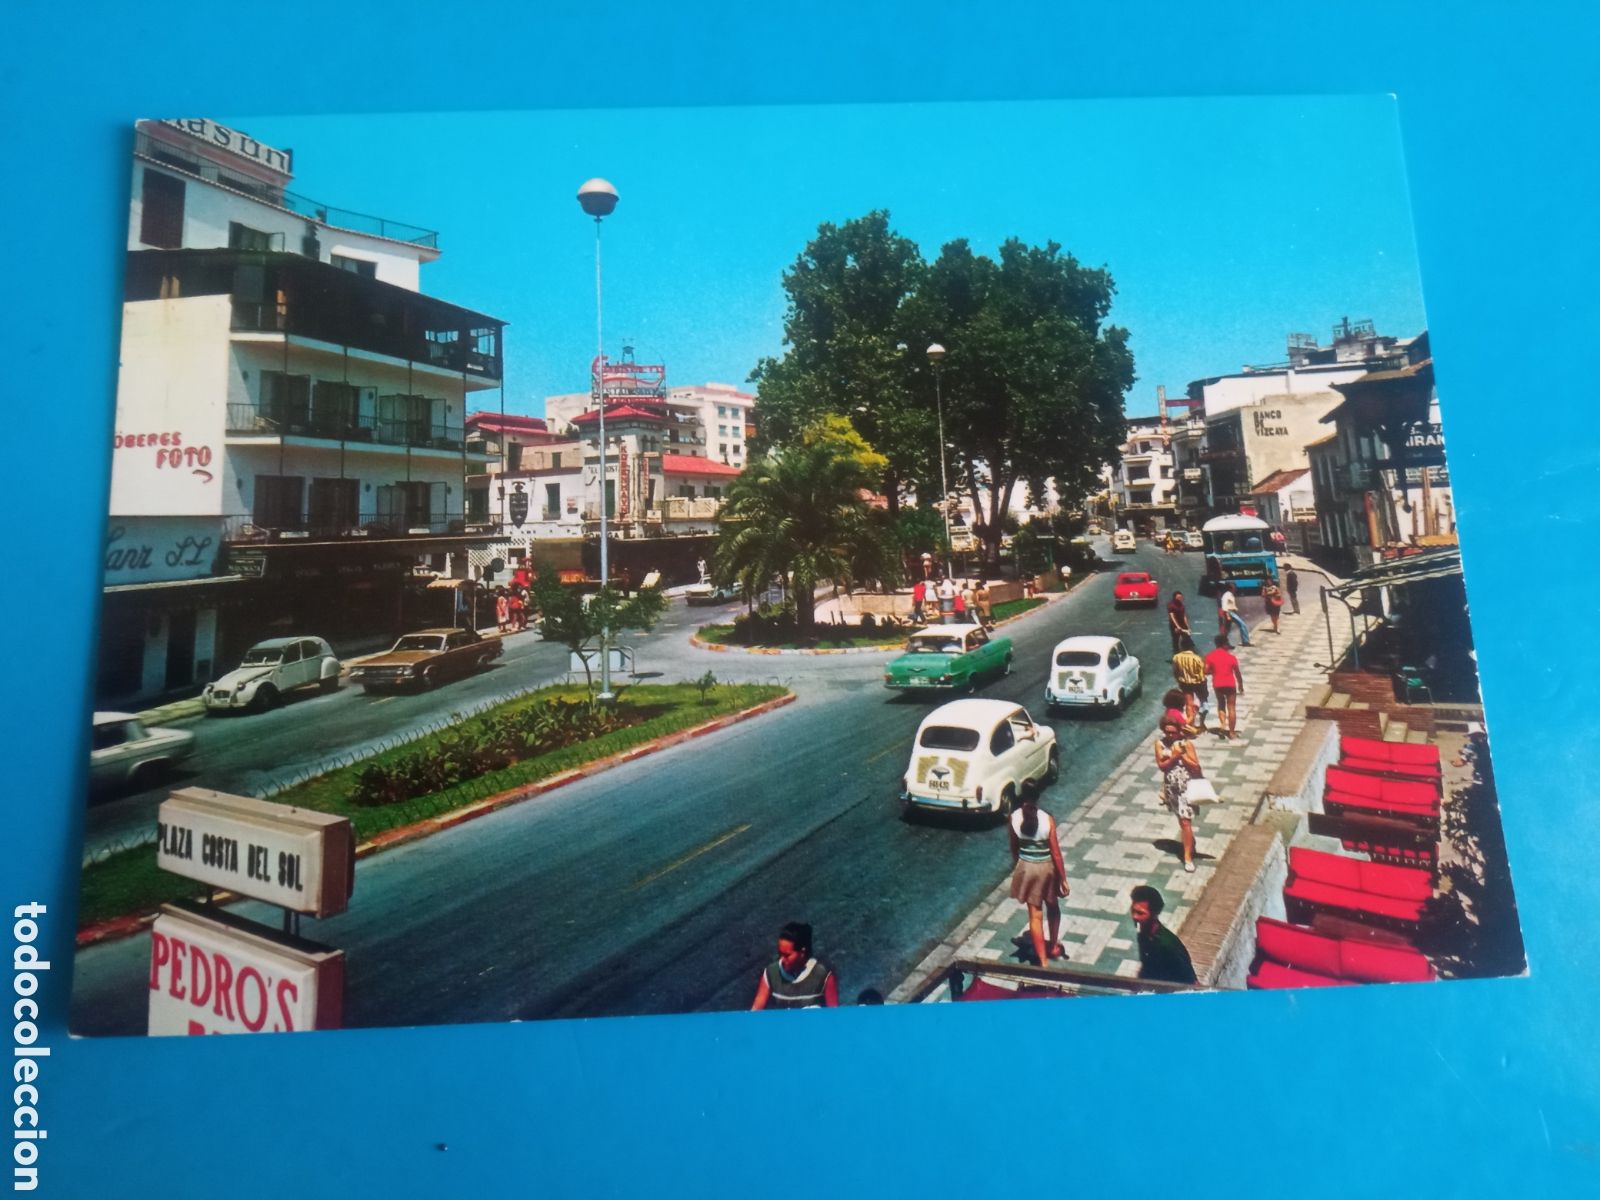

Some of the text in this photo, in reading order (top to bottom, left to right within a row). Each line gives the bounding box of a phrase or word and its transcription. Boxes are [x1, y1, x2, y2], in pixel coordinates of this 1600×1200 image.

[1253, 410, 1282, 419] BANCO
[1255, 426, 1289, 437] VIZCAYA
[156, 446, 212, 469] FOTO
[158, 822, 303, 892] PLAZA COSTA DEL SOL
[150, 931, 298, 1033] PEDRO'S
